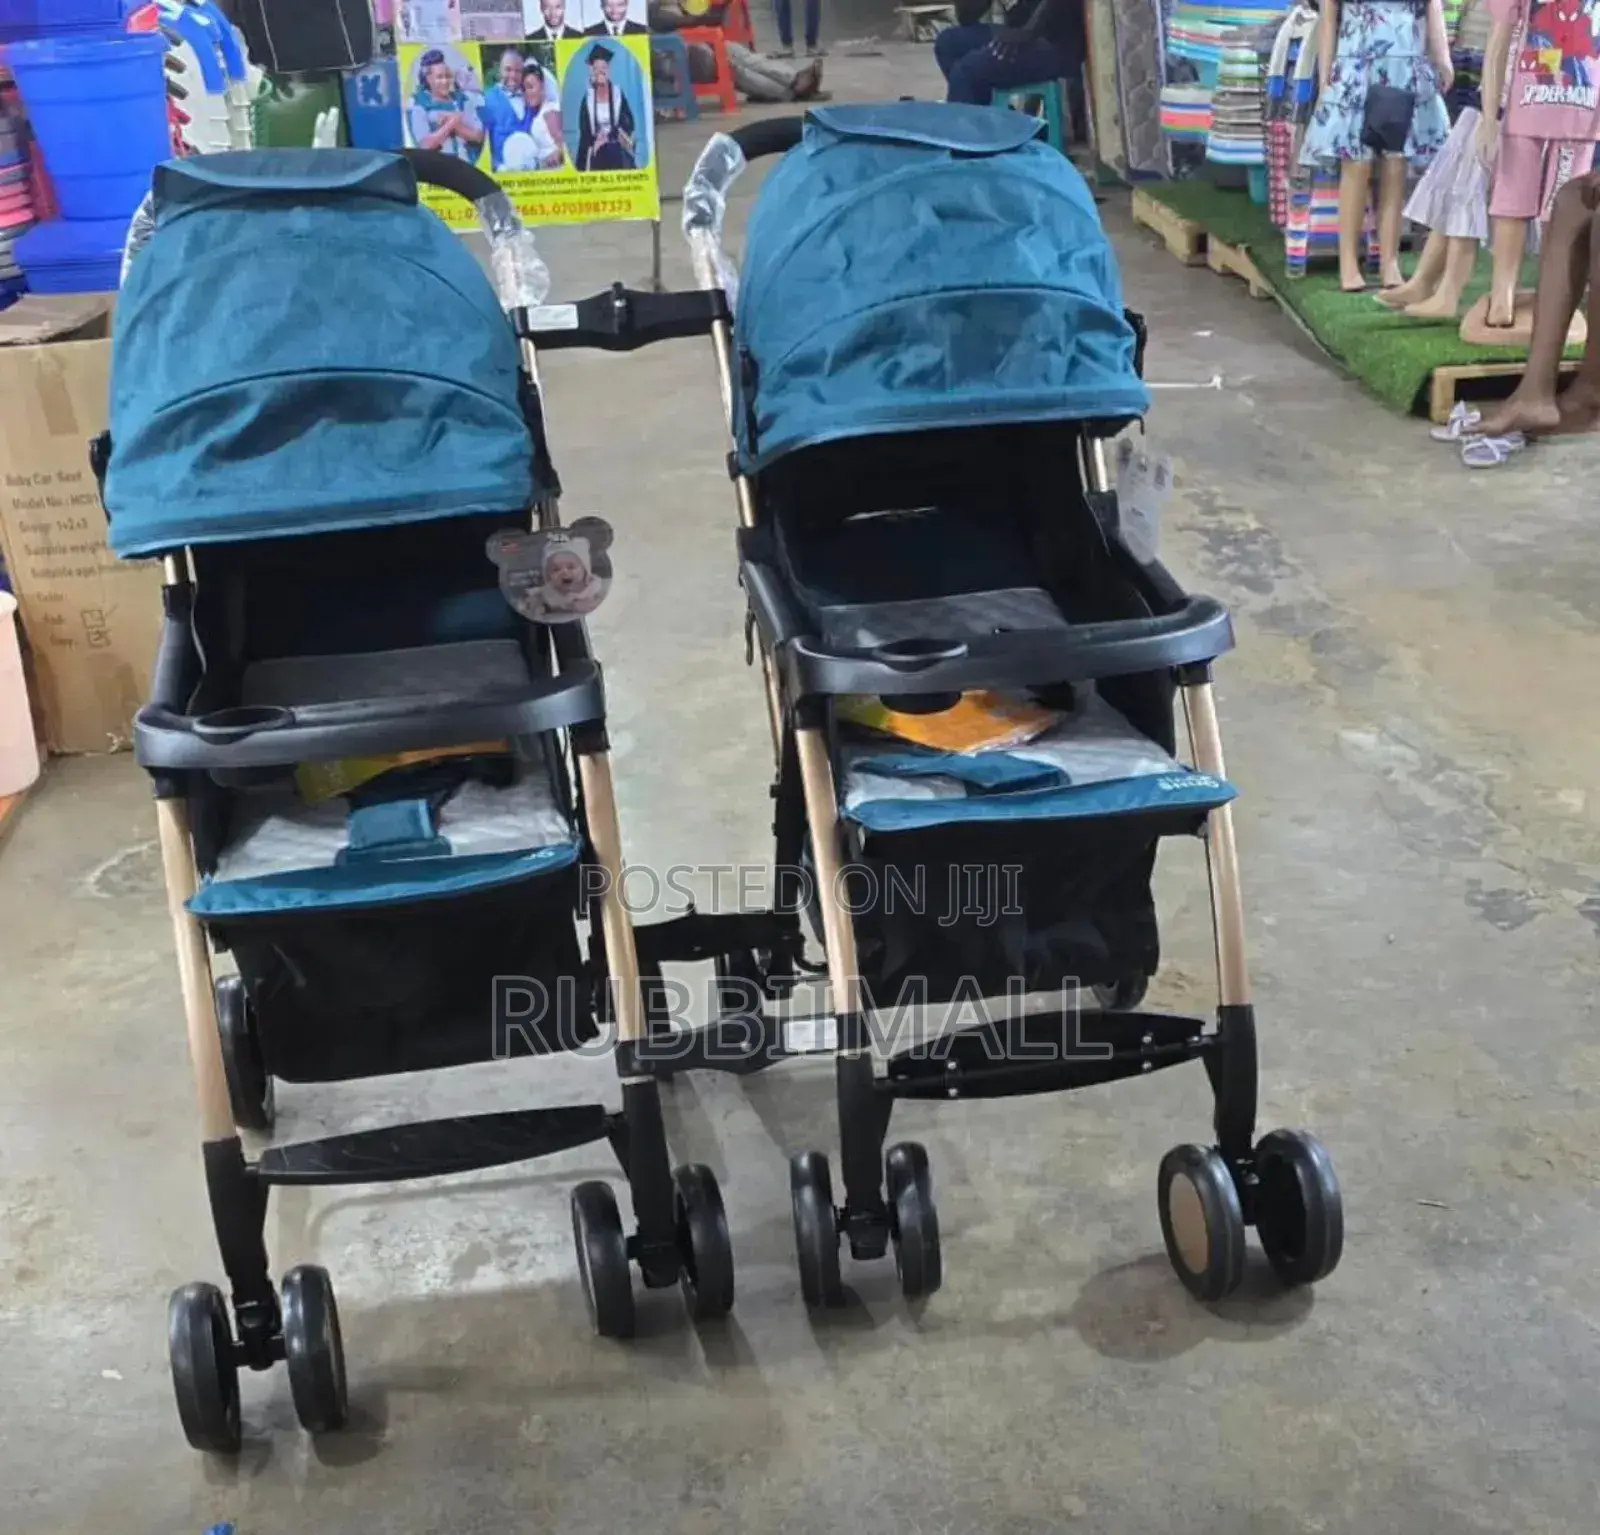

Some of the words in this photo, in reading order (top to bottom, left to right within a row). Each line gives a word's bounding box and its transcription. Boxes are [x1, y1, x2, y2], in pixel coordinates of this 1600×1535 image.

[580, 175, 598, 185] FOR
[600, 174, 614, 184] ALL
[33, 472, 52, 485] Car
[57, 469, 82, 483] Seat
